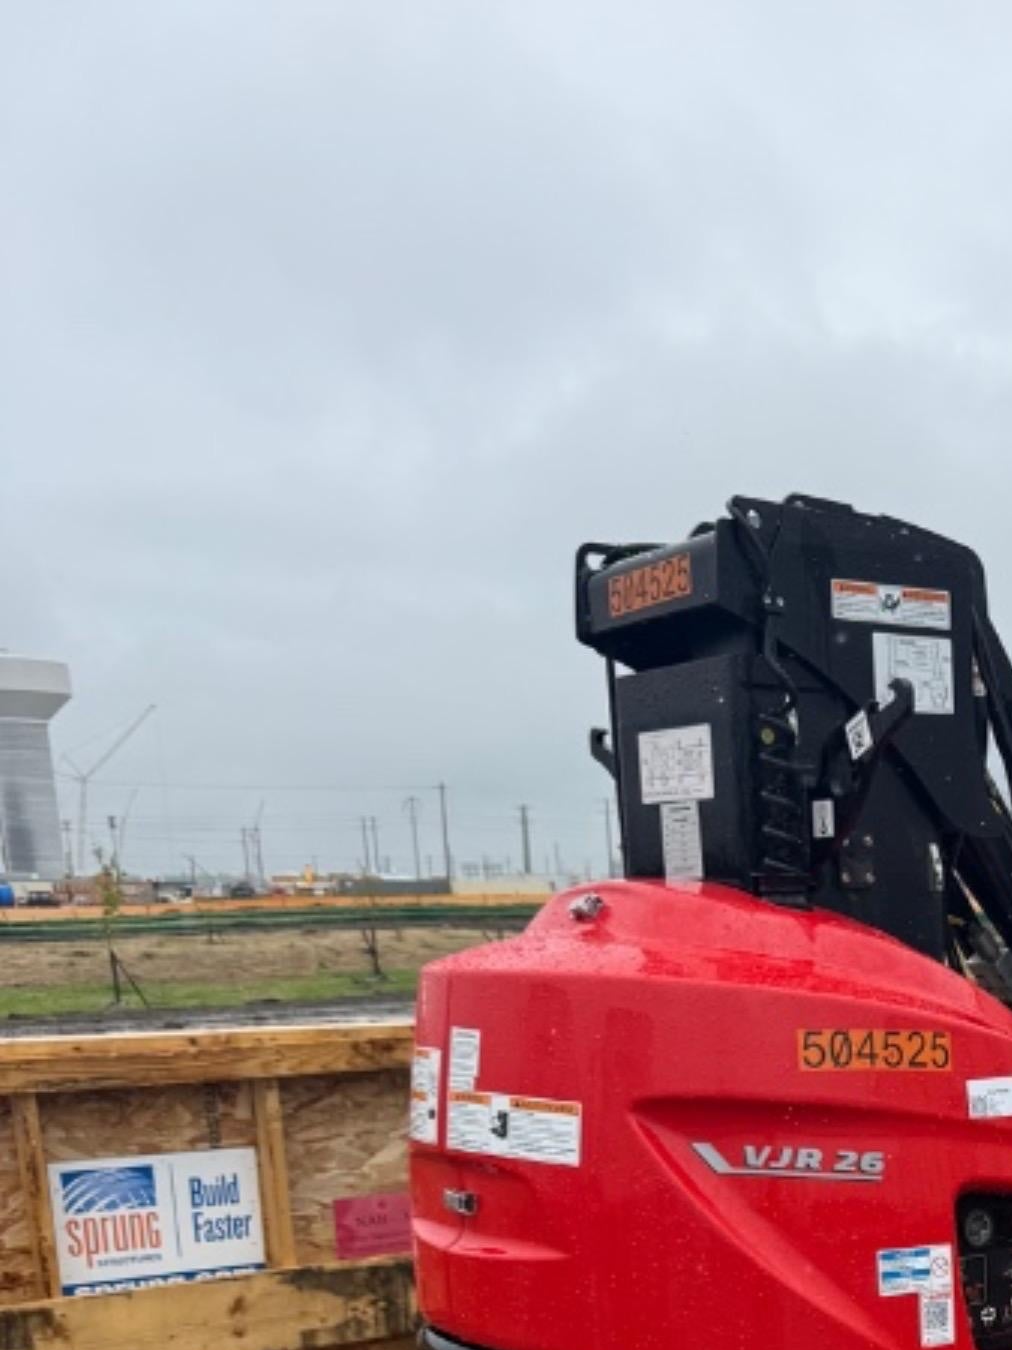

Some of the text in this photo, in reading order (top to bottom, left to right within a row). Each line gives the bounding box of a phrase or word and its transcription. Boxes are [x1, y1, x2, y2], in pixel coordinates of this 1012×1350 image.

[611, 556, 689, 613] 504525
[801, 1030, 950, 1069] 504525
[743, 1145, 885, 1173] VJR 26
[188, 1173, 241, 1208] Build
[193, 1211, 254, 1243] Faster
